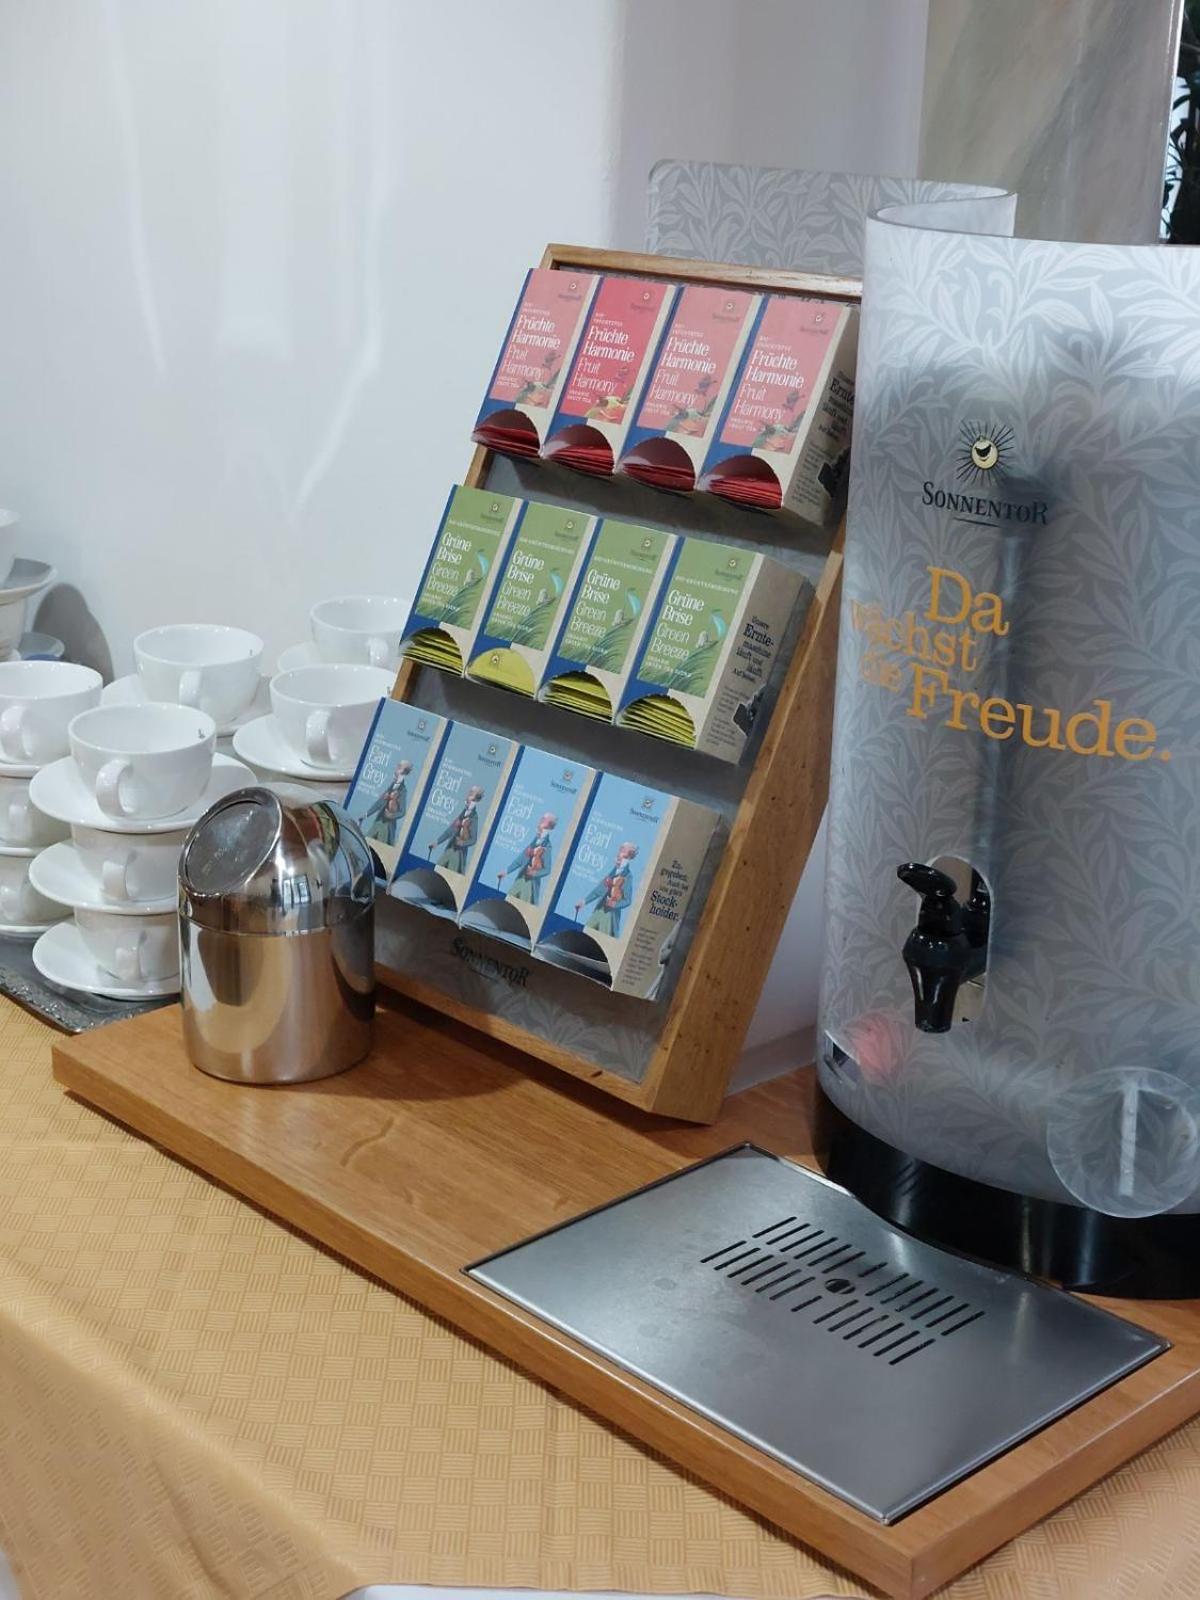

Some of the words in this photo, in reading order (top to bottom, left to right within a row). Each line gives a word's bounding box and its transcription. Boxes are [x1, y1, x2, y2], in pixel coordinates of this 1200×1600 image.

[516, 314, 555, 333] Früchte
[512, 328, 561, 349] Harmonie
[588, 325, 629, 345] Früchte
[582, 340, 635, 363] Harmonie
[667, 336, 710, 357] Früchte
[502, 361, 545, 381] Harmony
[661, 352, 717, 374] Harmonie
[752, 349, 798, 371] Früchte
[573, 371, 618, 396] Harmony
[746, 365, 805, 389] Harmonie
[650, 383, 698, 406] Harmony
[734, 399, 786, 421] Harmony
[443, 532, 472, 552] Grüne
[438, 546, 462, 565] Brise
[514, 549, 545, 571] Grüne
[508, 564, 535, 585] Brise
[588, 568, 621, 591] Grüne
[582, 583, 610, 604] Brise
[669, 589, 705, 611] Grüne
[924, 566, 1010, 636] Da
[663, 604, 694, 626] Brise
[906, 662, 1172, 762] Freude.
[369, 743, 392, 766] Earl
[363, 762, 388, 785] Grey
[437, 769, 463, 793] Earl
[432, 787, 456, 815] Grey
[508, 796, 534, 820] Earl
[502, 815, 529, 841] Grey
[586, 823, 613, 849] Earl
[579, 843, 607, 871] Grey
